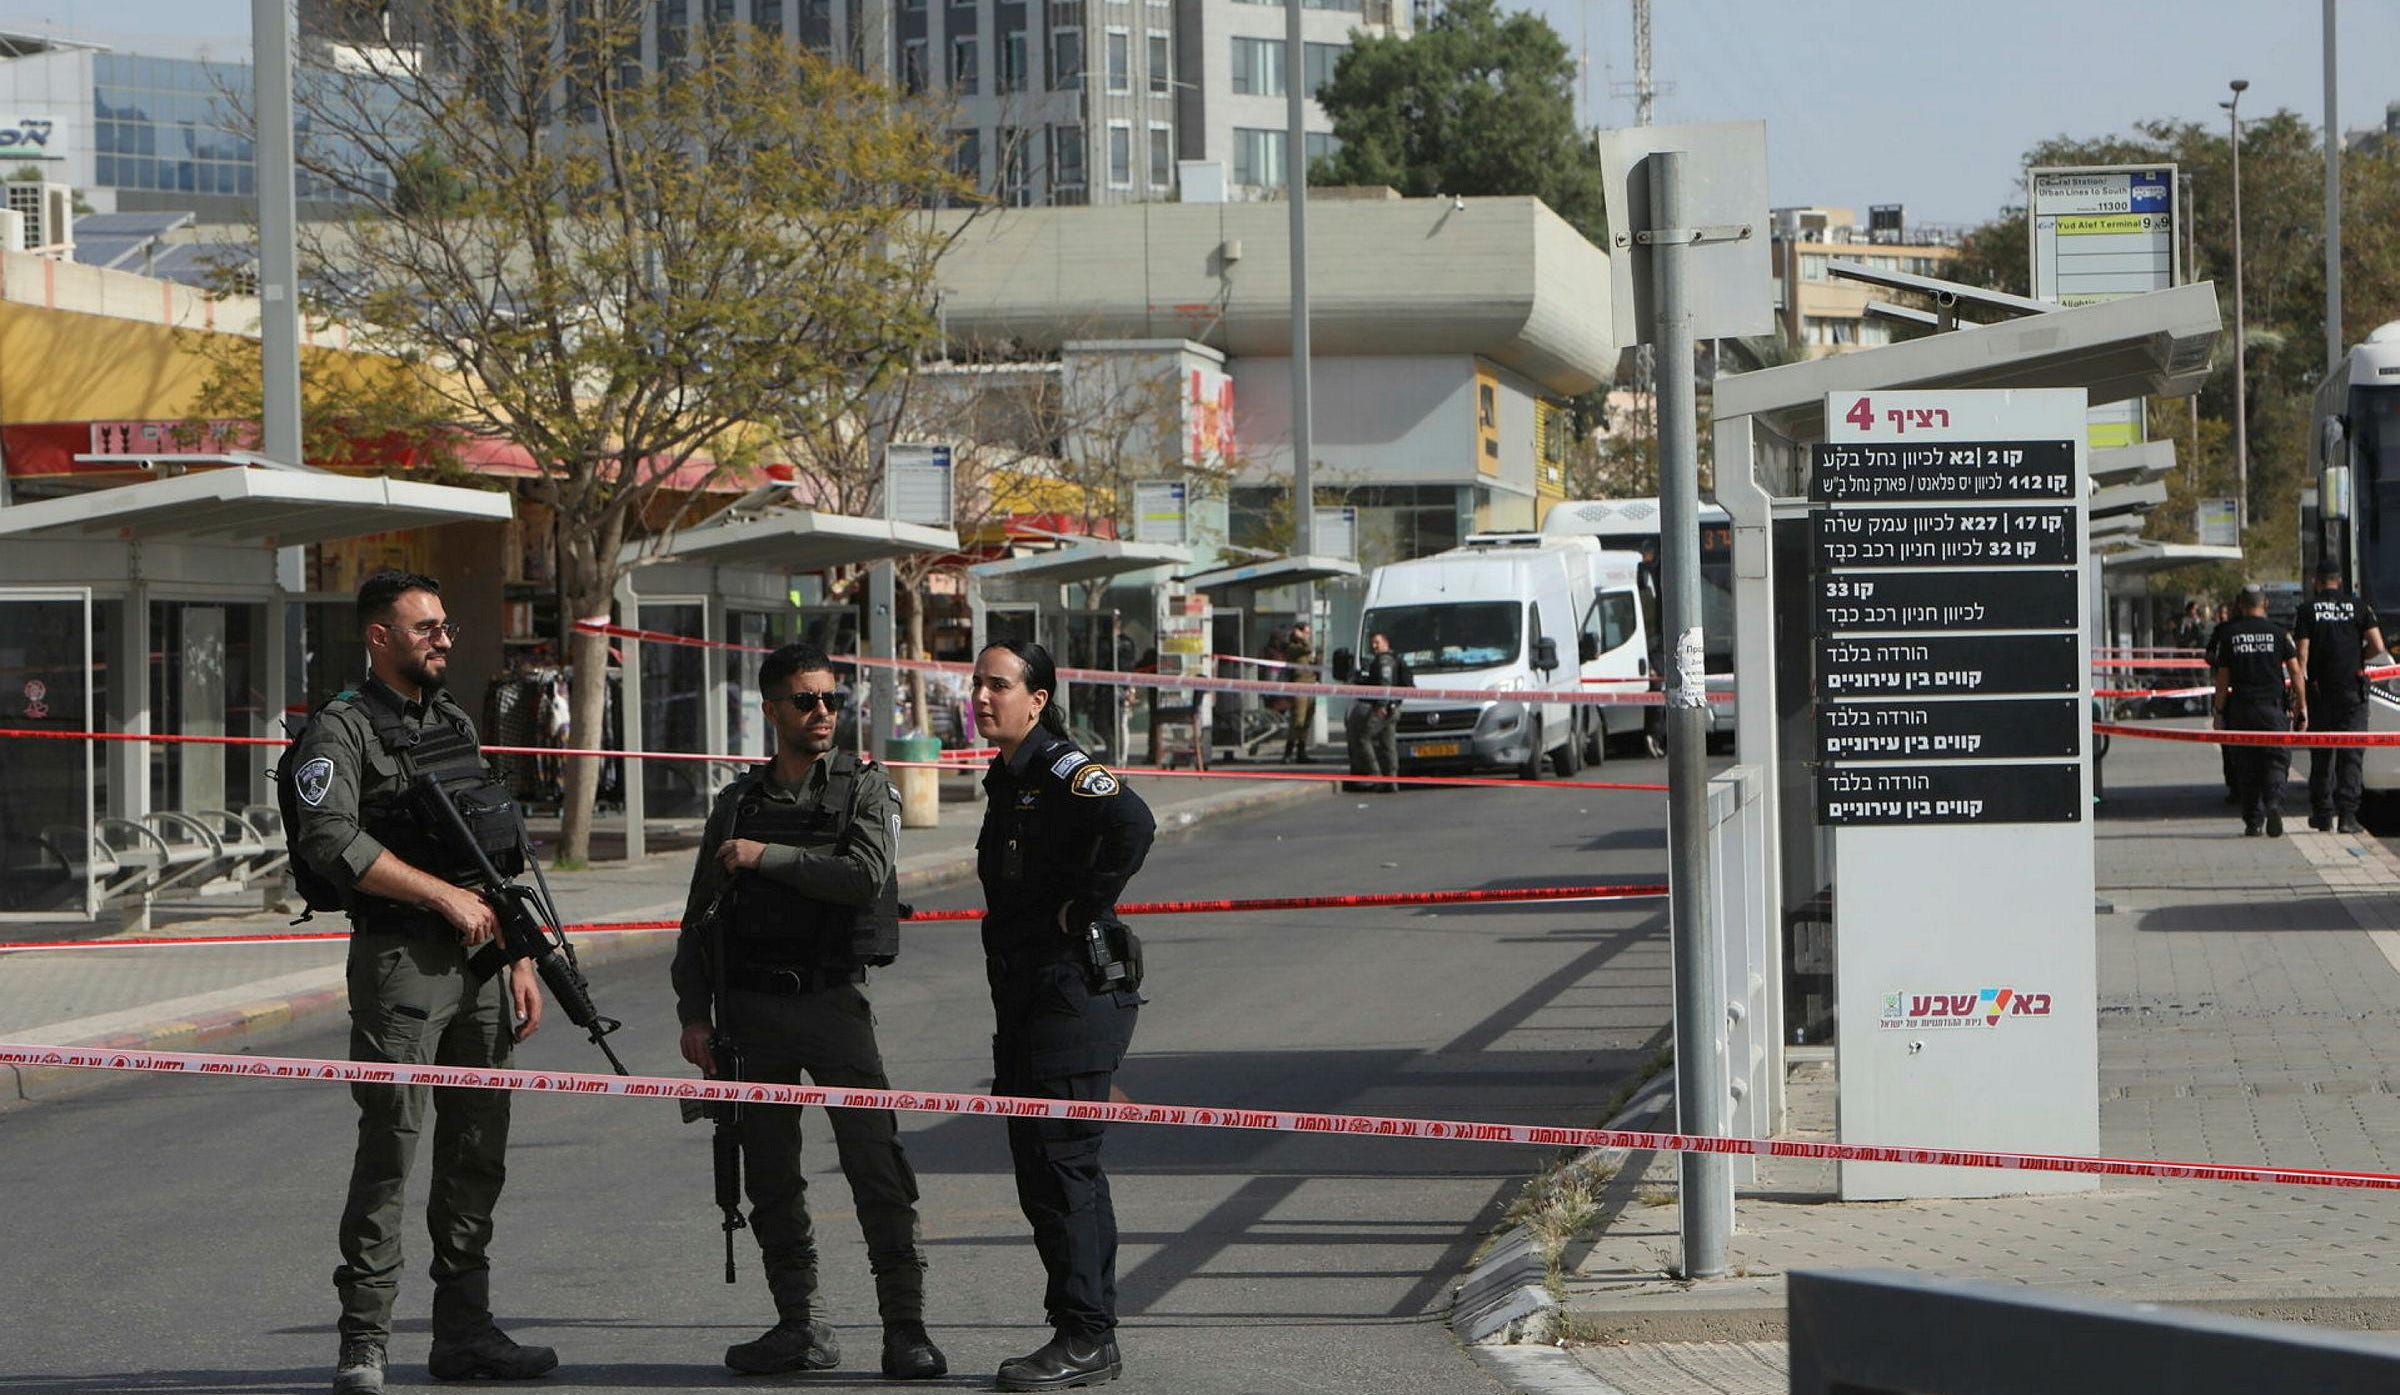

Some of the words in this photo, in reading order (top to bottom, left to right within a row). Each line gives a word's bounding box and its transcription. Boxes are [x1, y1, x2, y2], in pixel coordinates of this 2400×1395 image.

[2091, 187, 2100, 195] to
[2099, 203, 2128, 211] 11300
[2078, 221, 2097, 229] Alef
[2101, 219, 2141, 228] Terminal
[1846, 397, 1874, 431] 4
[1888, 409, 1949, 433] רציף
[1822, 450, 1860, 468] בקע
[1866, 449, 1896, 466] נחל
[1903, 448, 1943, 470] לכיוון
[1988, 451, 1998, 464] 2
[2004, 450, 2023, 465] קו
[1850, 475, 1870, 492] נחל
[1874, 476, 1906, 494] פארק
[1918, 475, 1955, 491] פלאנט
[1960, 477, 1971, 490] יס
[1975, 475, 2002, 496] לכיוון
[2009, 476, 2042, 490] 112
[2048, 475, 2067, 492] קו
[1825, 518, 1861, 533] שרה
[1868, 517, 1907, 535] עמק
[1914, 516, 1954, 535] לכיוון
[2015, 516, 2037, 529] 17
[2042, 516, 2062, 531] קו
[1825, 544, 1857, 559] כבד
[1863, 543, 1894, 557] רכב
[1901, 542, 1935, 560] חניון
[1942, 539, 1982, 560] לכיוון
[1989, 541, 2011, 556] 32
[2016, 541, 2036, 556] קו
[1826, 583, 1849, 597] 33
[1854, 583, 1873, 599] קו
[1827, 607, 1859, 623] כבד
[1865, 607, 1896, 621] רכב
[1903, 606, 1937, 625] חניון
[1944, 603, 1985, 624] לכיוון
[2232, 634, 2274, 643] משטרה
[1827, 646, 1871, 662] בלבד
[1877, 646, 1928, 661] הורדה
[1828, 672, 1900, 688] עירוניים
[1906, 672, 1932, 689] בין
[1935, 670, 1982, 687] קווים
[1826, 709, 1870, 726] בלבד
[1876, 710, 1927, 724] הורדה
[1827, 737, 1899, 752] עירוניים
[1905, 736, 1928, 753] בין
[1935, 735, 1981, 751] קווים
[1828, 773, 1872, 791] בלבד
[1879, 775, 1929, 789] הורדה
[1829, 801, 1901, 817] עירוניים
[1906, 801, 1931, 818] בין
[1936, 799, 1983, 815] קווים
[1910, 995, 1977, 1017] שבע
